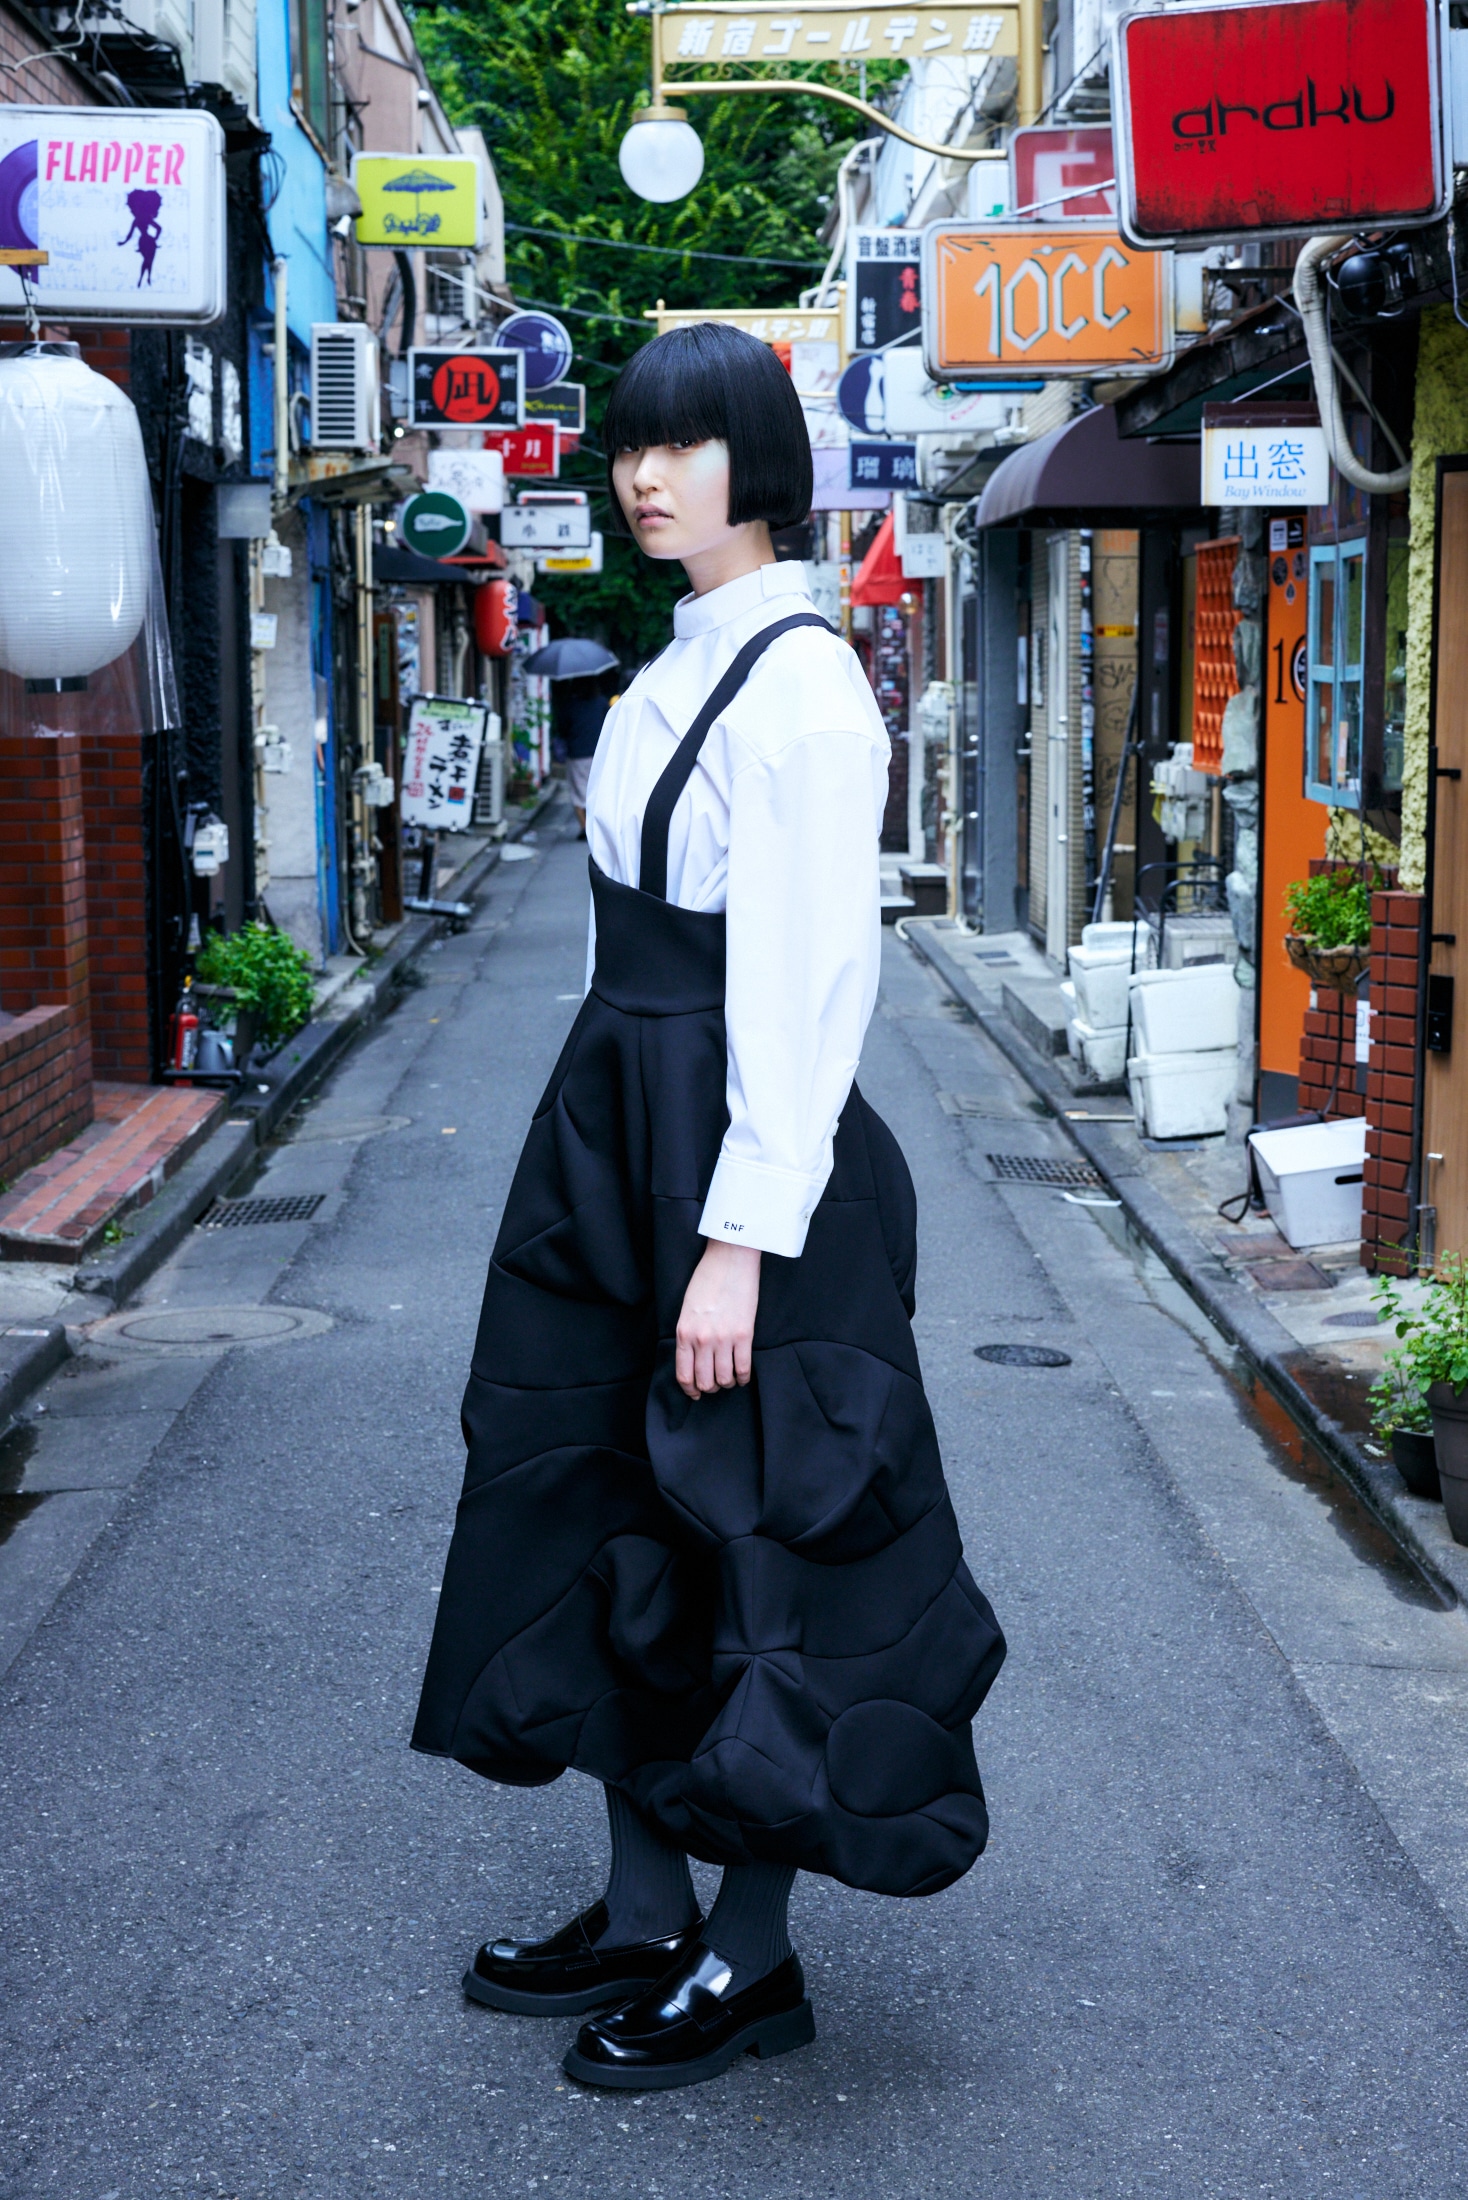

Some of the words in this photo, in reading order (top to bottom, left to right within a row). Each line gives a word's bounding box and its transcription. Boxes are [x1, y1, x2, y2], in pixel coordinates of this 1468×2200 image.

[677, 14, 1004, 58] 新宿ゴールデン街
[45, 140, 186, 186] FLAPPER
[973, 245, 1131, 359] 10CC
[443, 366, 494, 413] 凪
[1224, 440, 1306, 480] 出窓
[1224, 485, 1250, 500] Bay
[1252, 484, 1306, 498] Window
[723, 1220, 745, 1232] ENF
